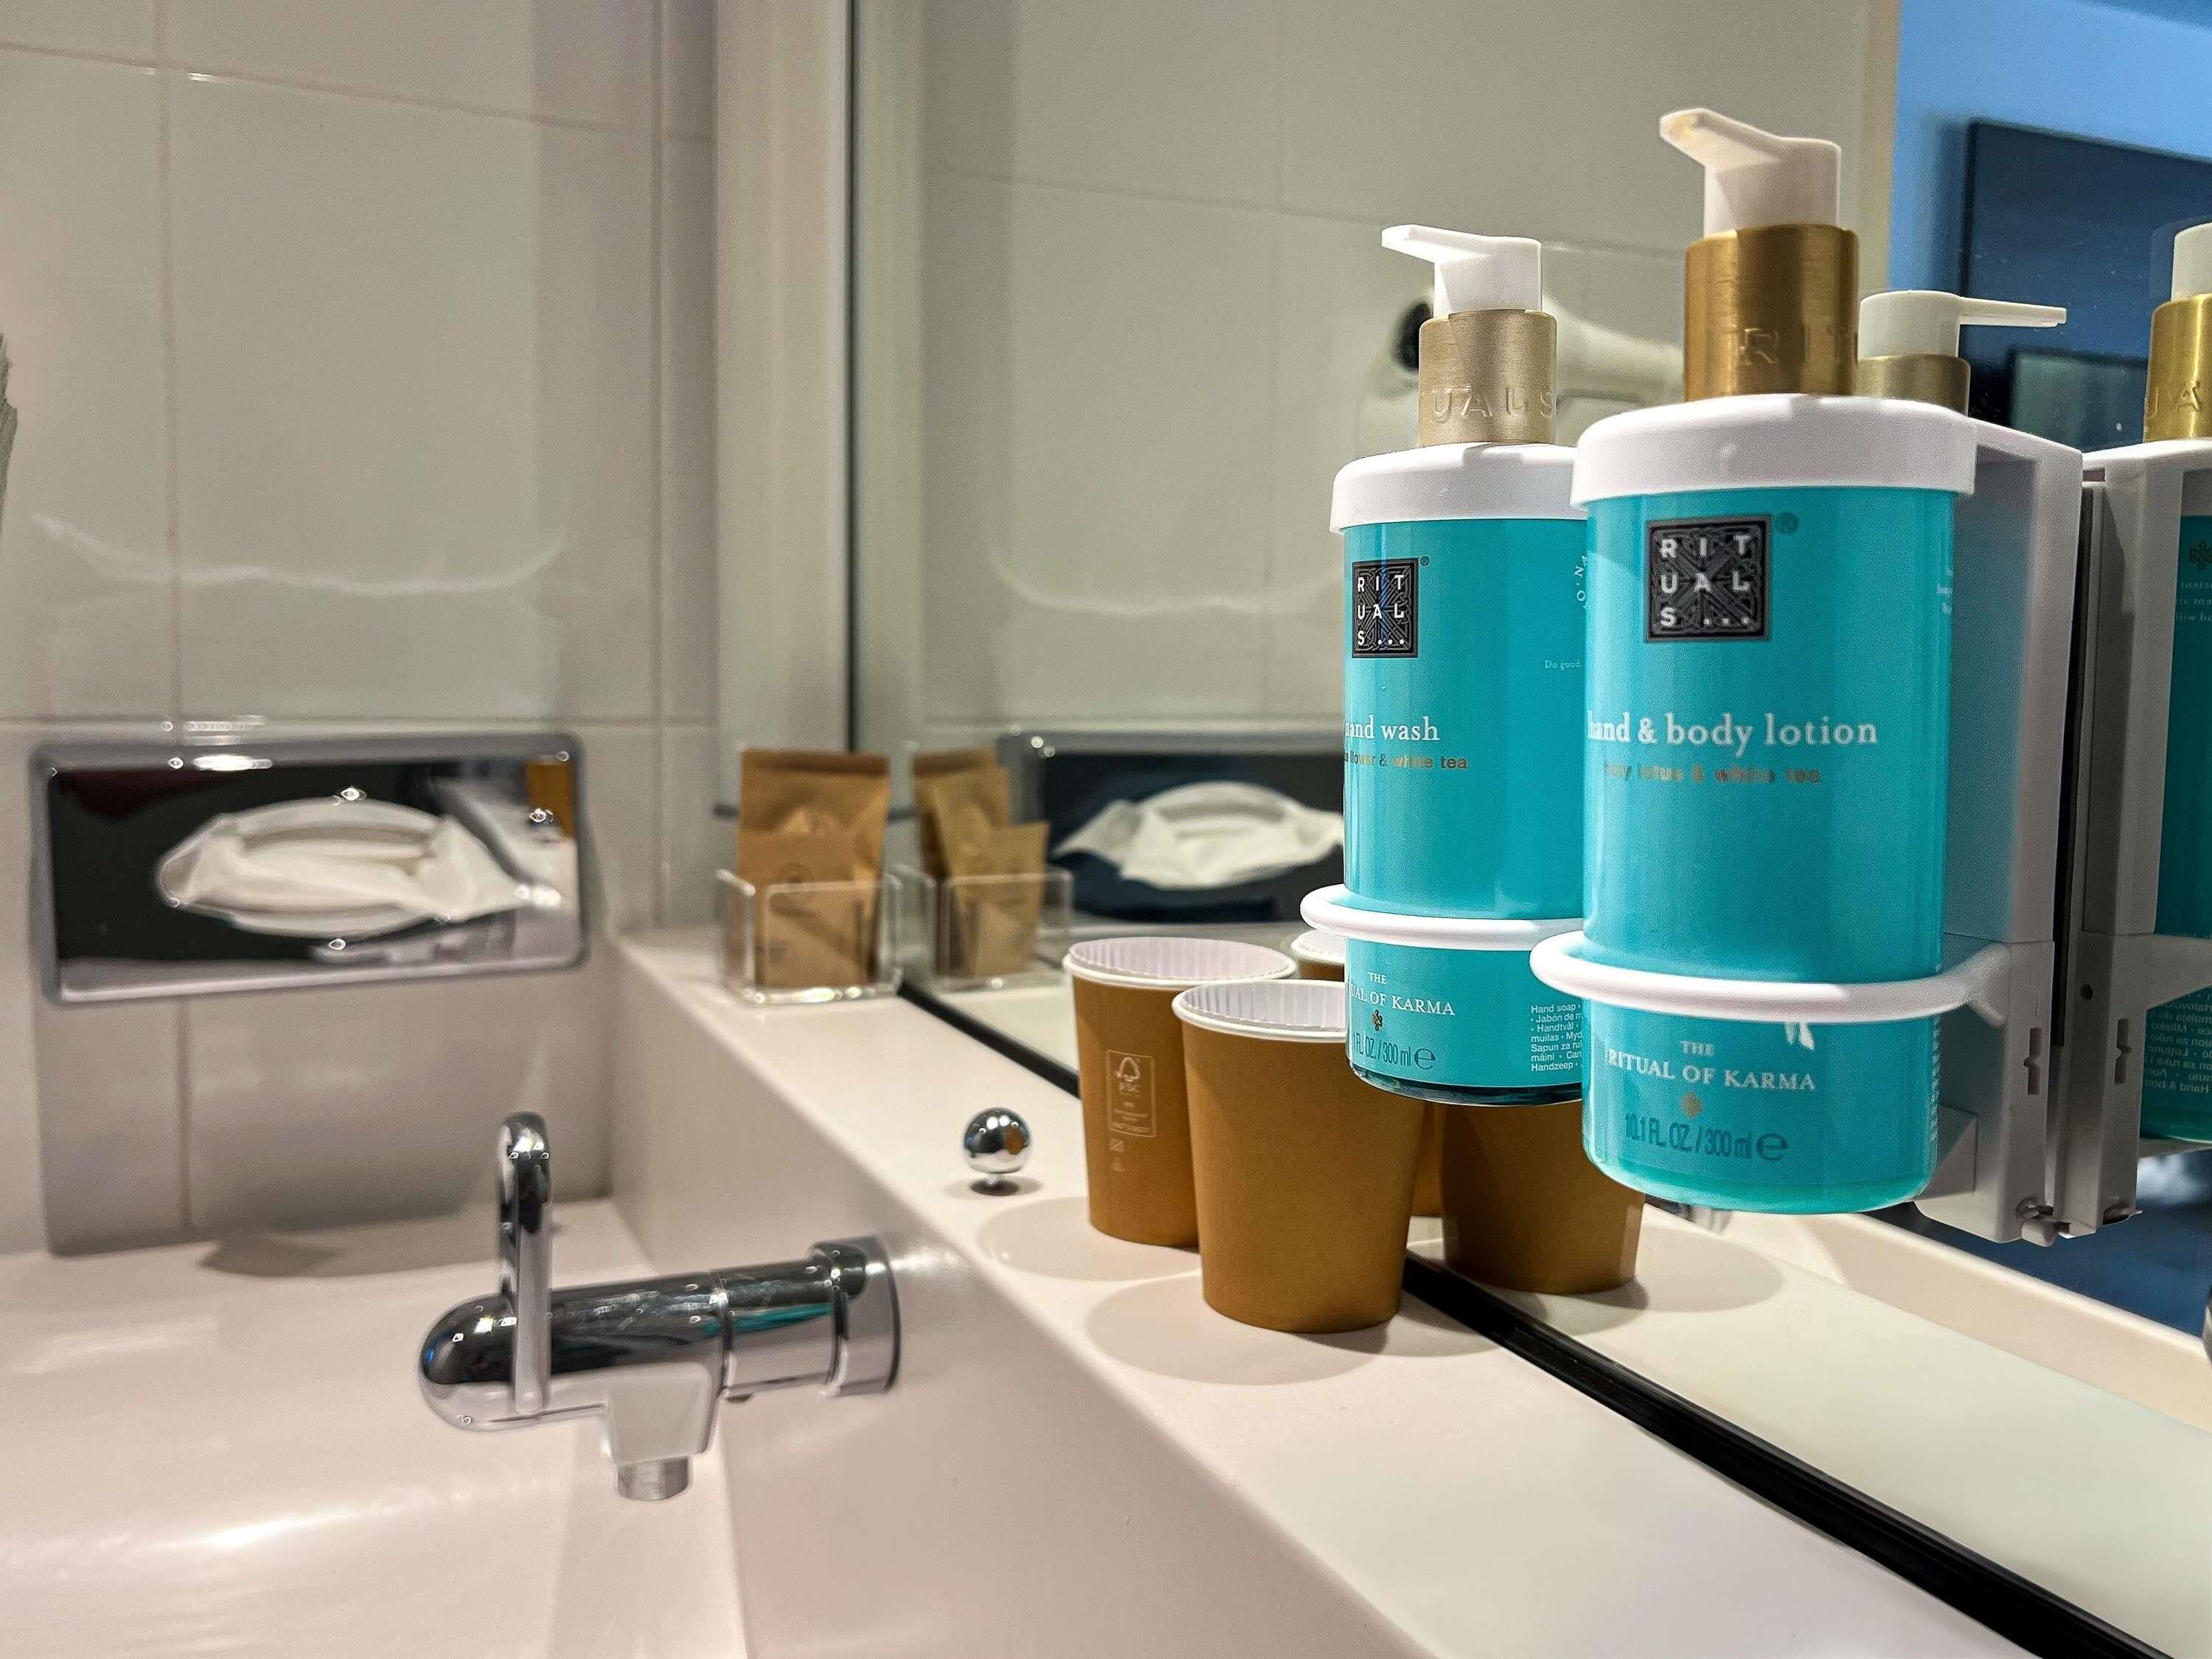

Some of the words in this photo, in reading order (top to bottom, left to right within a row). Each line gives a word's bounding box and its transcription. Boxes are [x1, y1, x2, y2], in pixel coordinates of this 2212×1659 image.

[1380, 715, 1440, 741] wash
[1587, 710, 1630, 743] hand
[1638, 716, 1658, 744] &
[1666, 712, 1753, 759] body
[1764, 712, 1877, 746] lotion
[1440, 755, 1467, 770] tea
[1368, 971, 1388, 985] THE
[1349, 981, 1368, 1002] UAL
[1369, 991, 1387, 1006] OF
[1391, 995, 1455, 1016] KARMA
[1531, 1004, 1555, 1014] Hand
[1557, 1004, 1576, 1013] soap
[1531, 1043, 1559, 1053] Sapun
[1560, 1042, 1571, 1051] za
[1681, 1040, 1714, 1056] THE
[1605, 1048, 1676, 1080] RITUAL
[1682, 1065, 1716, 1085] OF
[1725, 1068, 1816, 1091] KARMA
